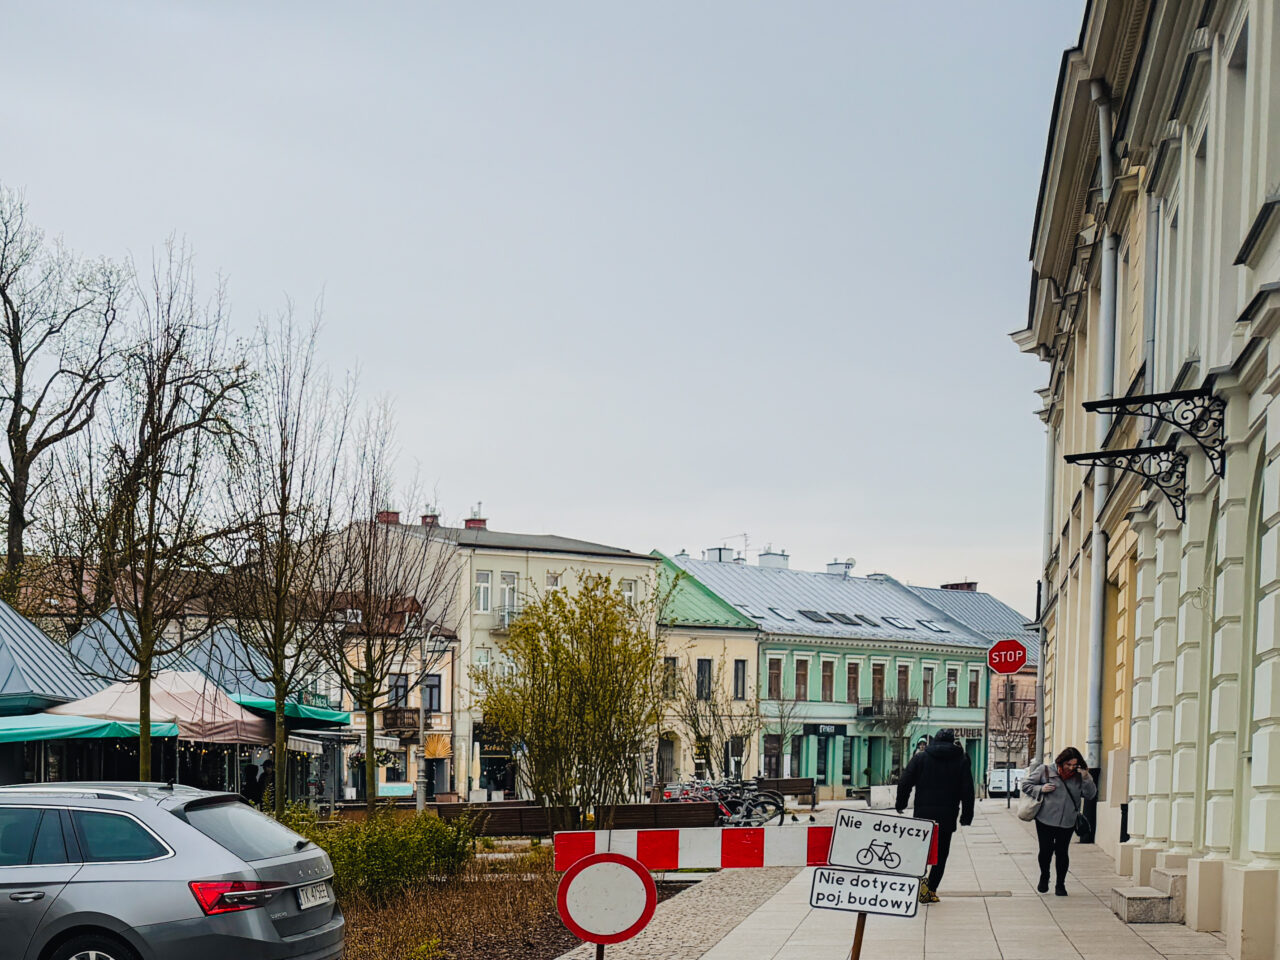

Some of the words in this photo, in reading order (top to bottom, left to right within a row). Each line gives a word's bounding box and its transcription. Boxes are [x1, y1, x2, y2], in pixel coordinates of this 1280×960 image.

[992, 650, 1024, 663] STOP
[839, 814, 862, 829] Nie
[873, 820, 930, 842] dotyczy
[818, 871, 845, 885] Nie
[850, 875, 916, 896] dotyczy
[815, 890, 844, 906] poj.
[847, 892, 913, 914] budowy
